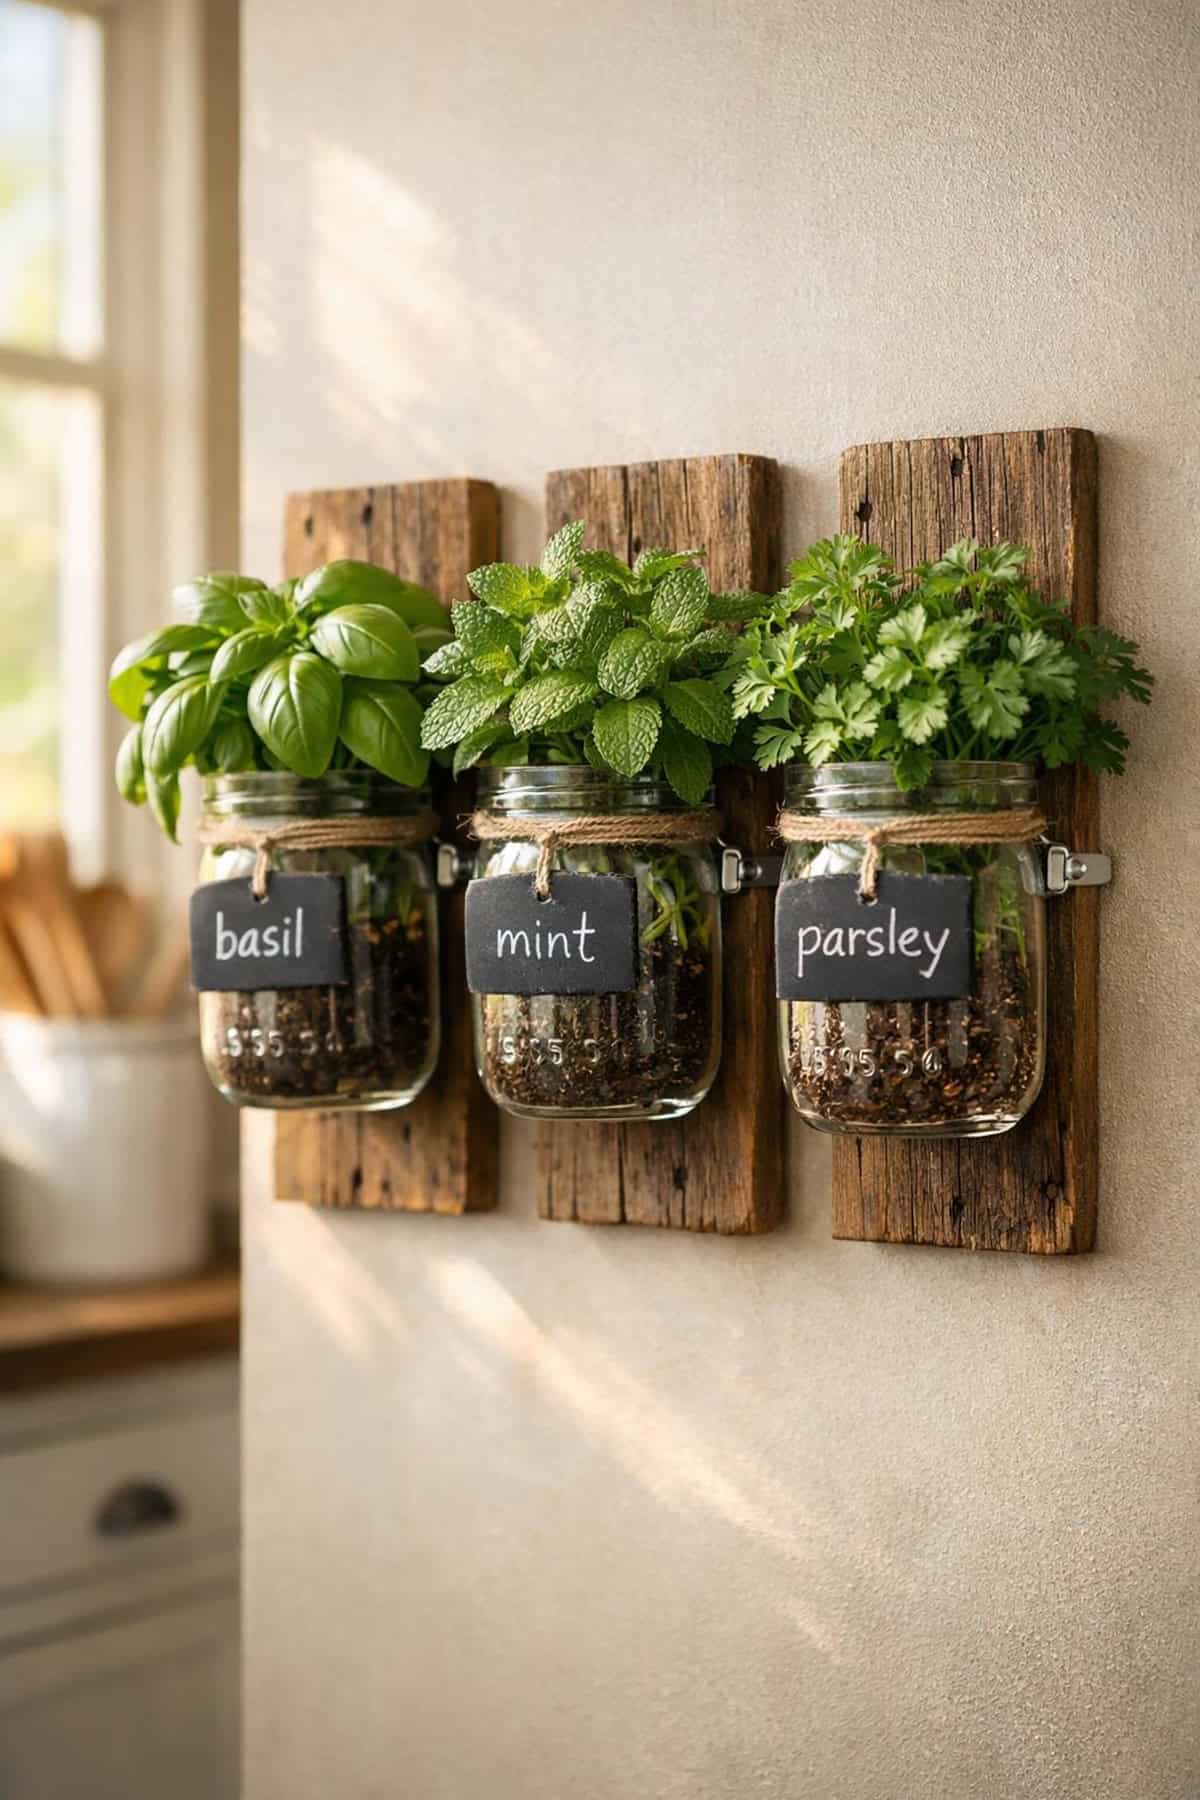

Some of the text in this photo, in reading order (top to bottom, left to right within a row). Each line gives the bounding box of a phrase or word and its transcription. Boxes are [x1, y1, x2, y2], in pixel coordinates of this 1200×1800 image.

[215, 907, 303, 961] basil
[497, 911, 596, 963] mint
[797, 907, 950, 979] parsley
